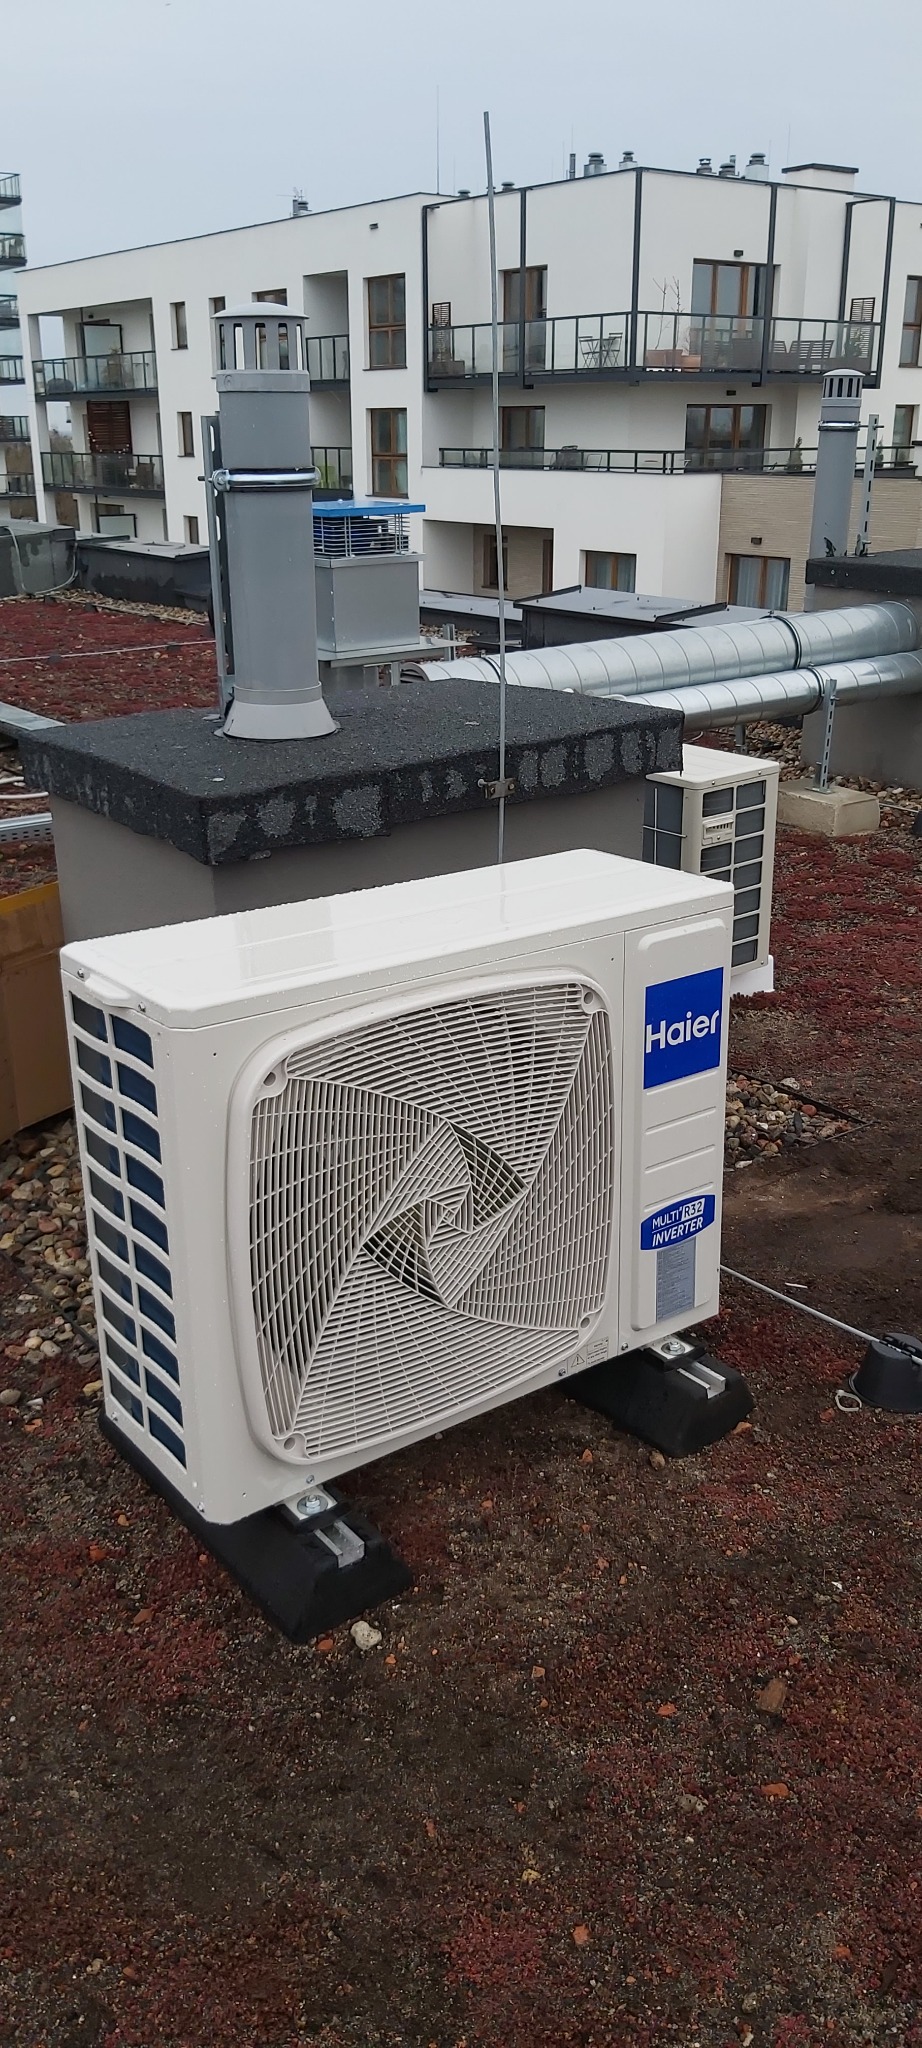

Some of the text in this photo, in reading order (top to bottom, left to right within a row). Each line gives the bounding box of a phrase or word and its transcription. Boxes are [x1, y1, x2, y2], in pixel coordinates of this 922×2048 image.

[645, 1009, 720, 1054] Haier
[684, 1201, 703, 1218] R32
[652, 1216, 704, 1247] INVERTER
